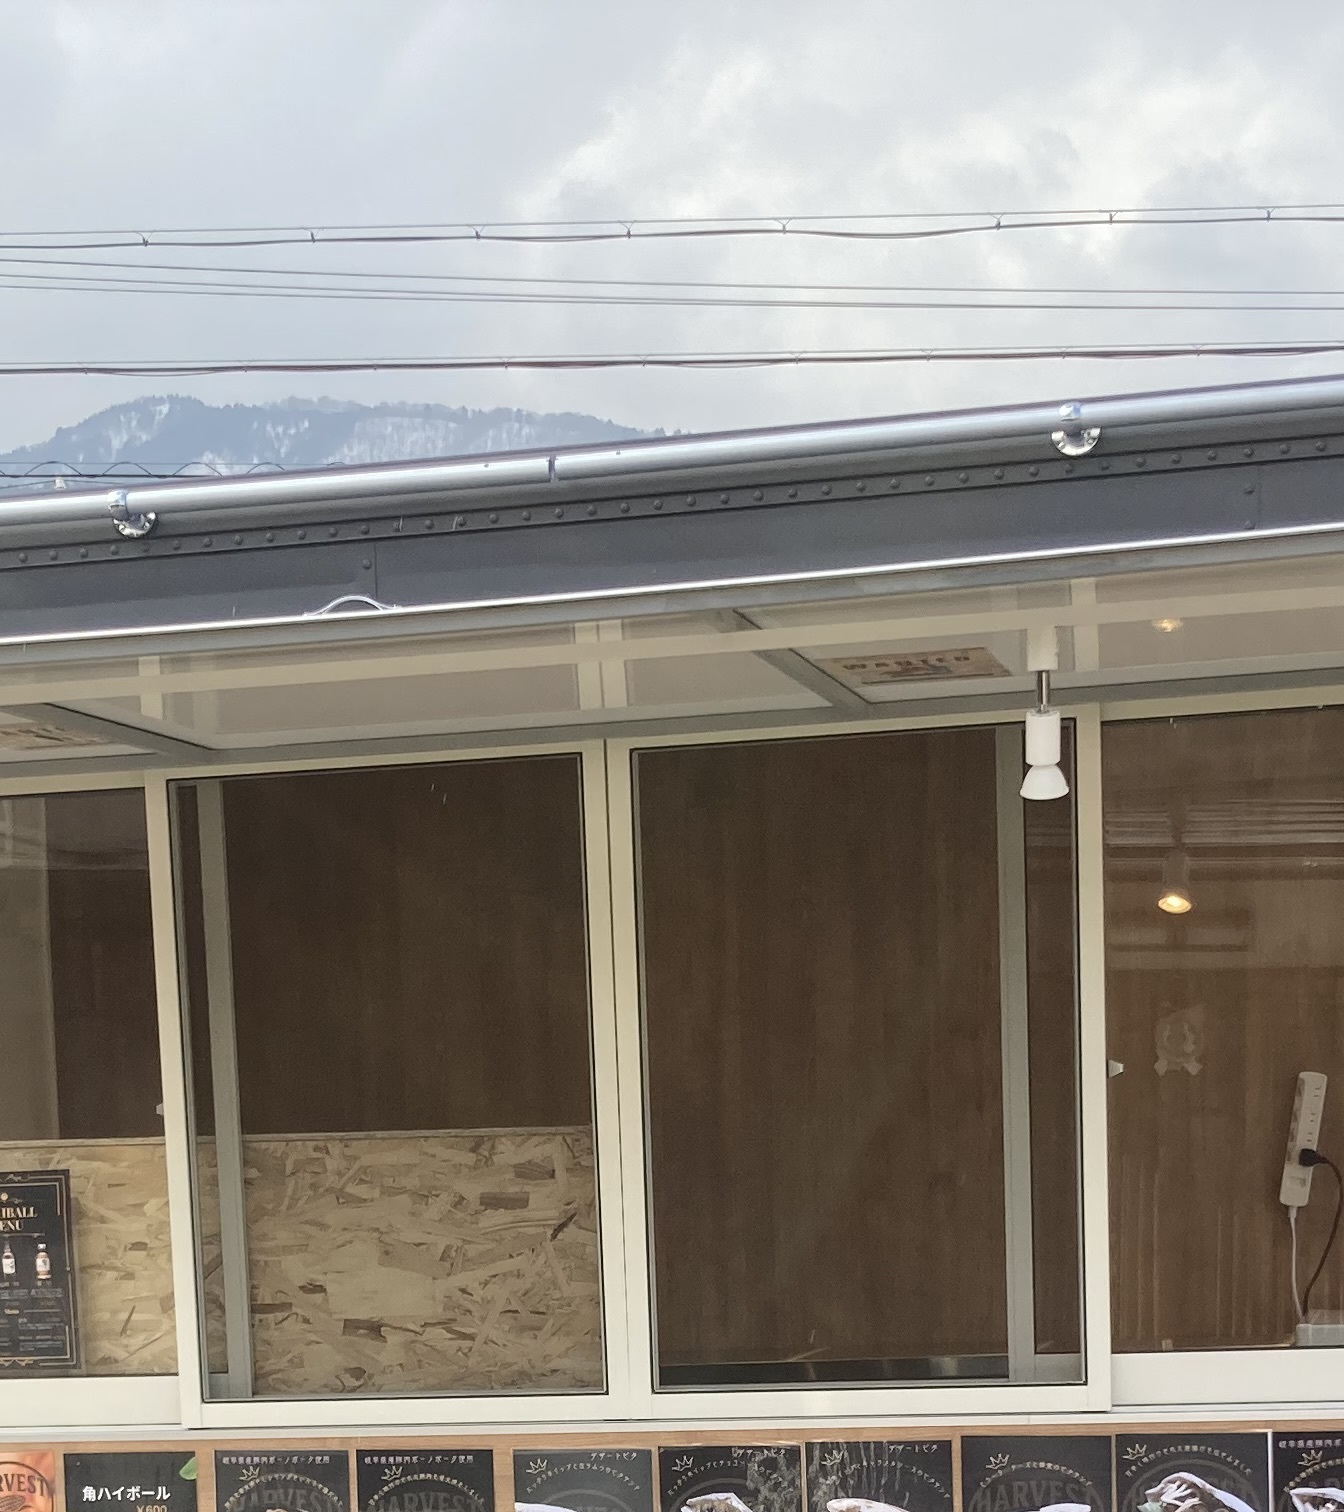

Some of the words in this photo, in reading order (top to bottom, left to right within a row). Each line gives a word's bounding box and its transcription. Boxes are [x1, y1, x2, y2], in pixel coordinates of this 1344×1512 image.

[82, 1486, 171, 1502] 角ハイボール
